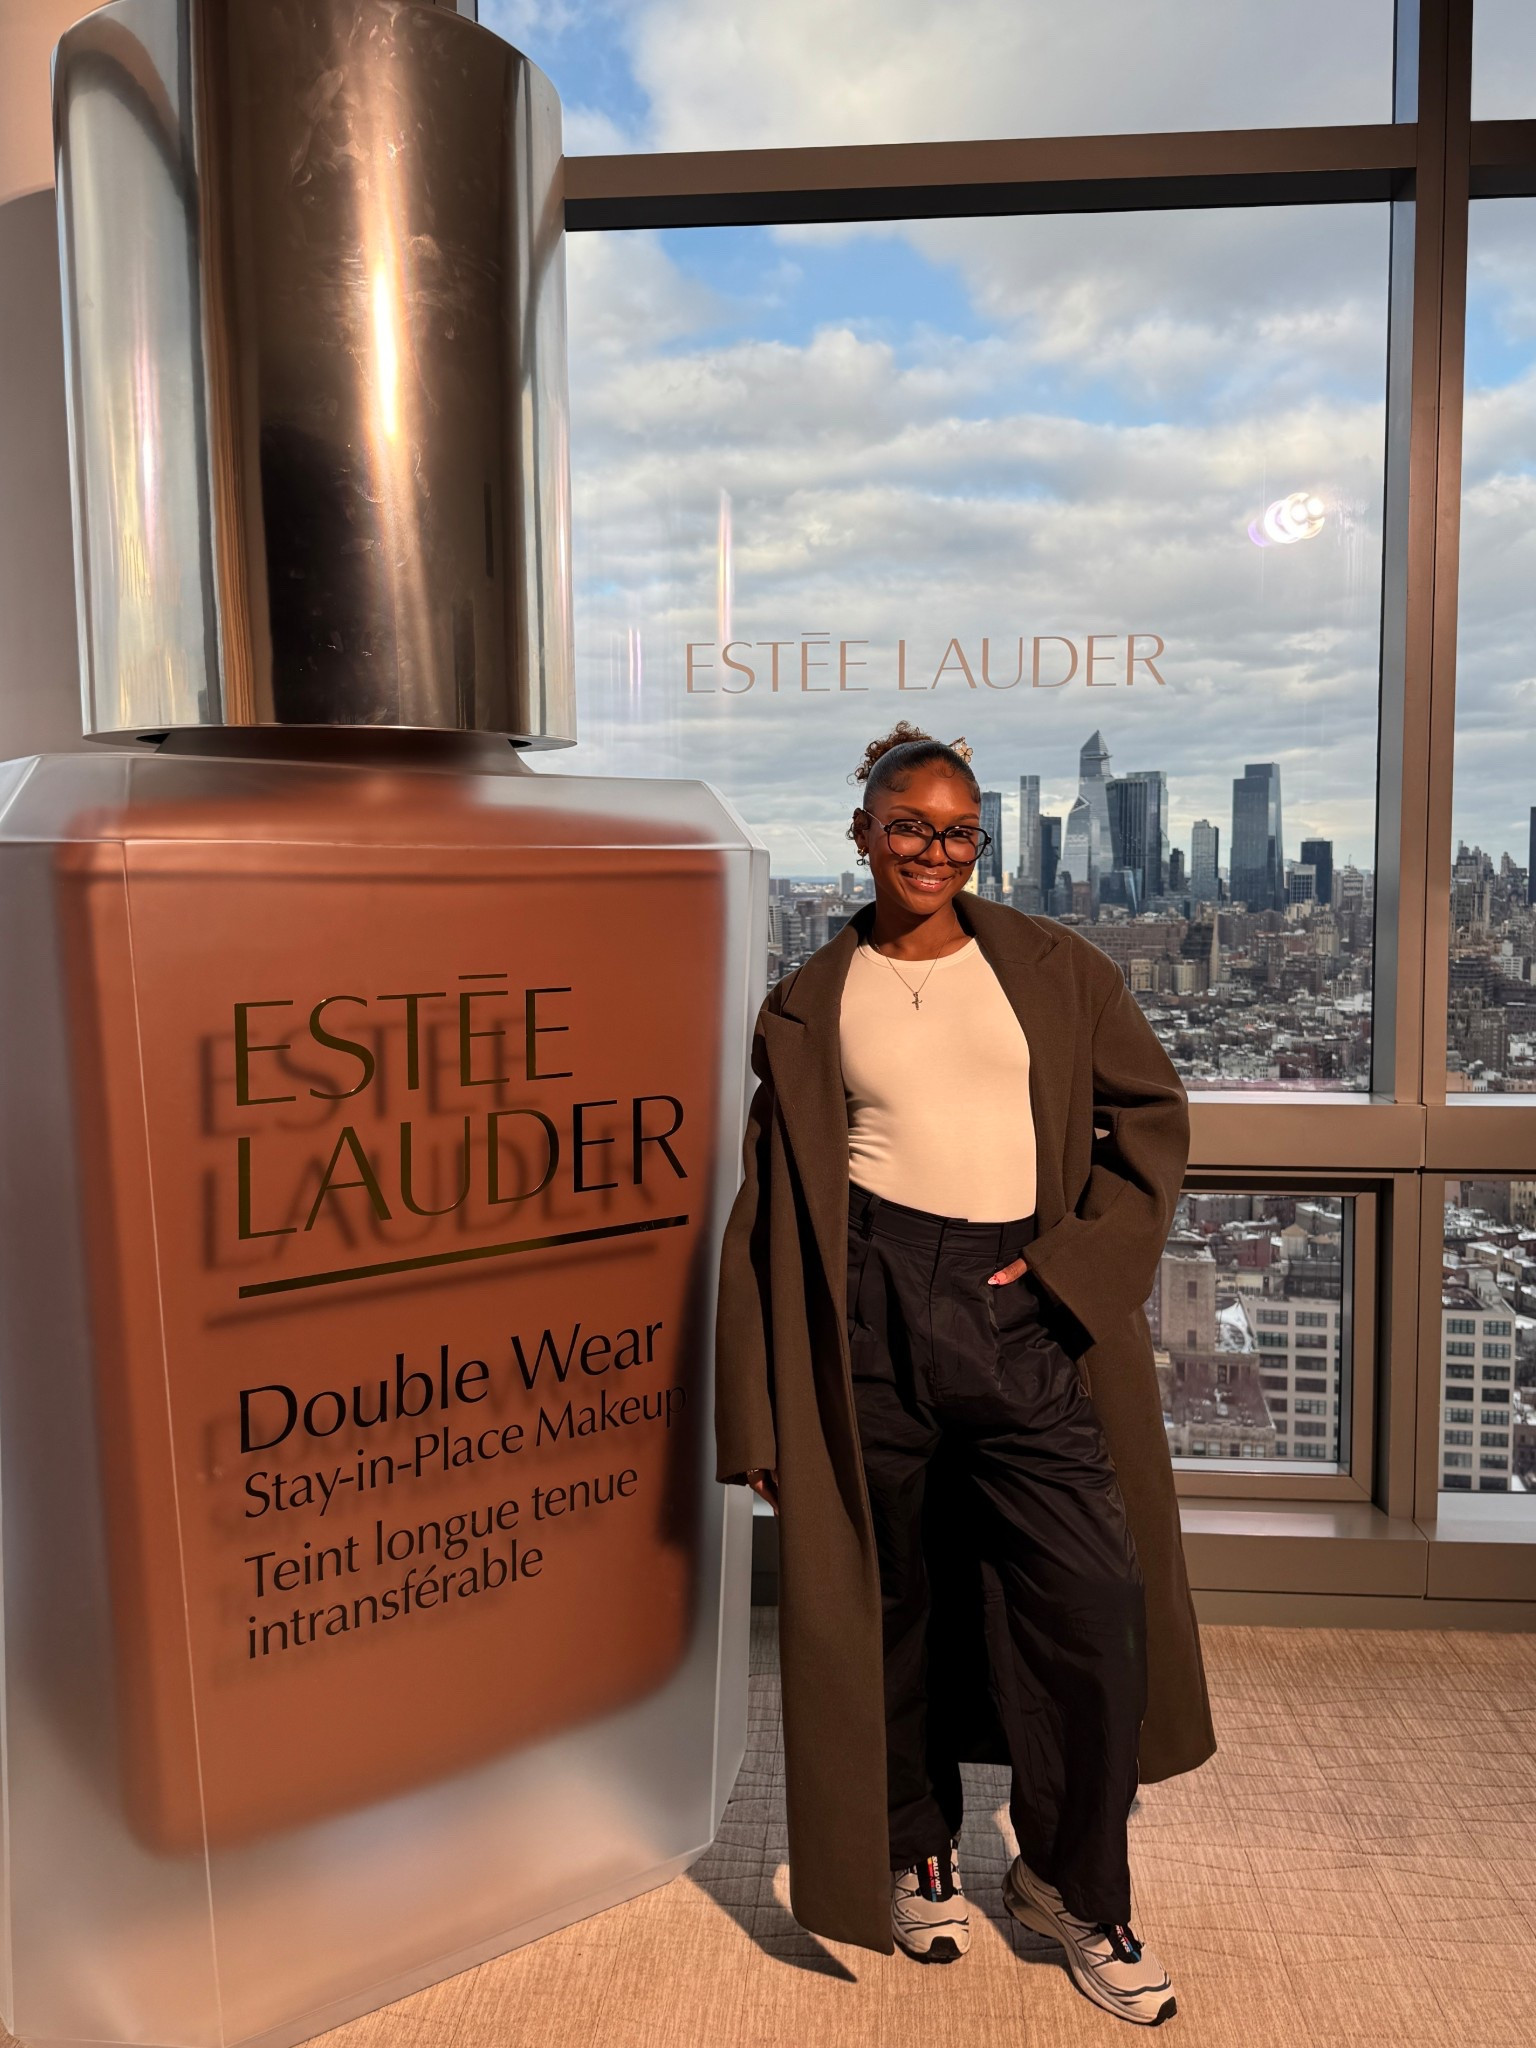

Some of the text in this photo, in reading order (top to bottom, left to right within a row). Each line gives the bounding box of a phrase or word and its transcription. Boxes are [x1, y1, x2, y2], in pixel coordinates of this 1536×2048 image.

[898, 633, 1167, 691] LAUDER
[238, 1094, 689, 1241] LAUDER
[239, 1321, 663, 1454] Double Wear
[244, 1385, 687, 1518] Stay-in-Place Makeup
[244, 1468, 639, 1599] Teint longue tenue
[248, 1538, 544, 1660] intransférable
